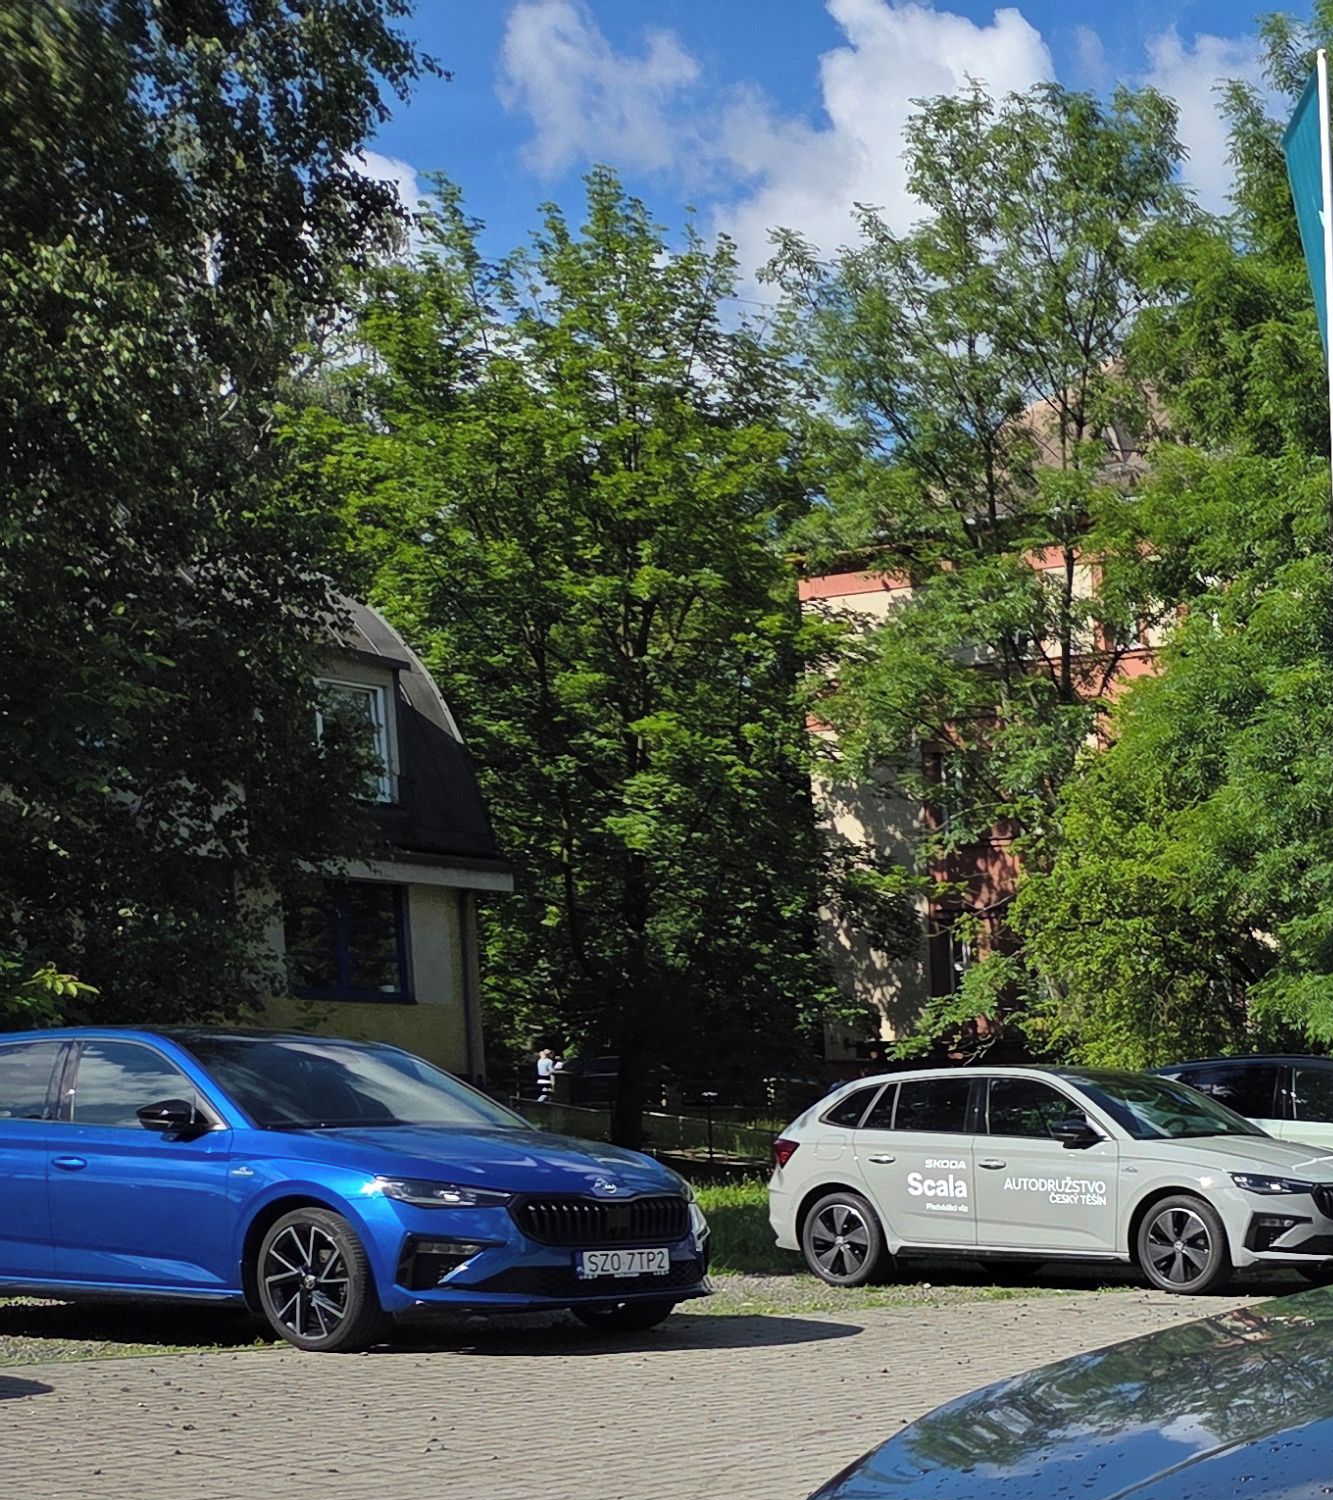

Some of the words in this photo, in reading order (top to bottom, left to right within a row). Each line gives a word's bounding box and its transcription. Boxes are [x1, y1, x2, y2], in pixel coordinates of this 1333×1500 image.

[907, 1172, 968, 1198] Scala
[1003, 1176, 1106, 1194] AUTODRUŽSTVO
[625, 1250, 665, 1271] 7TP2
